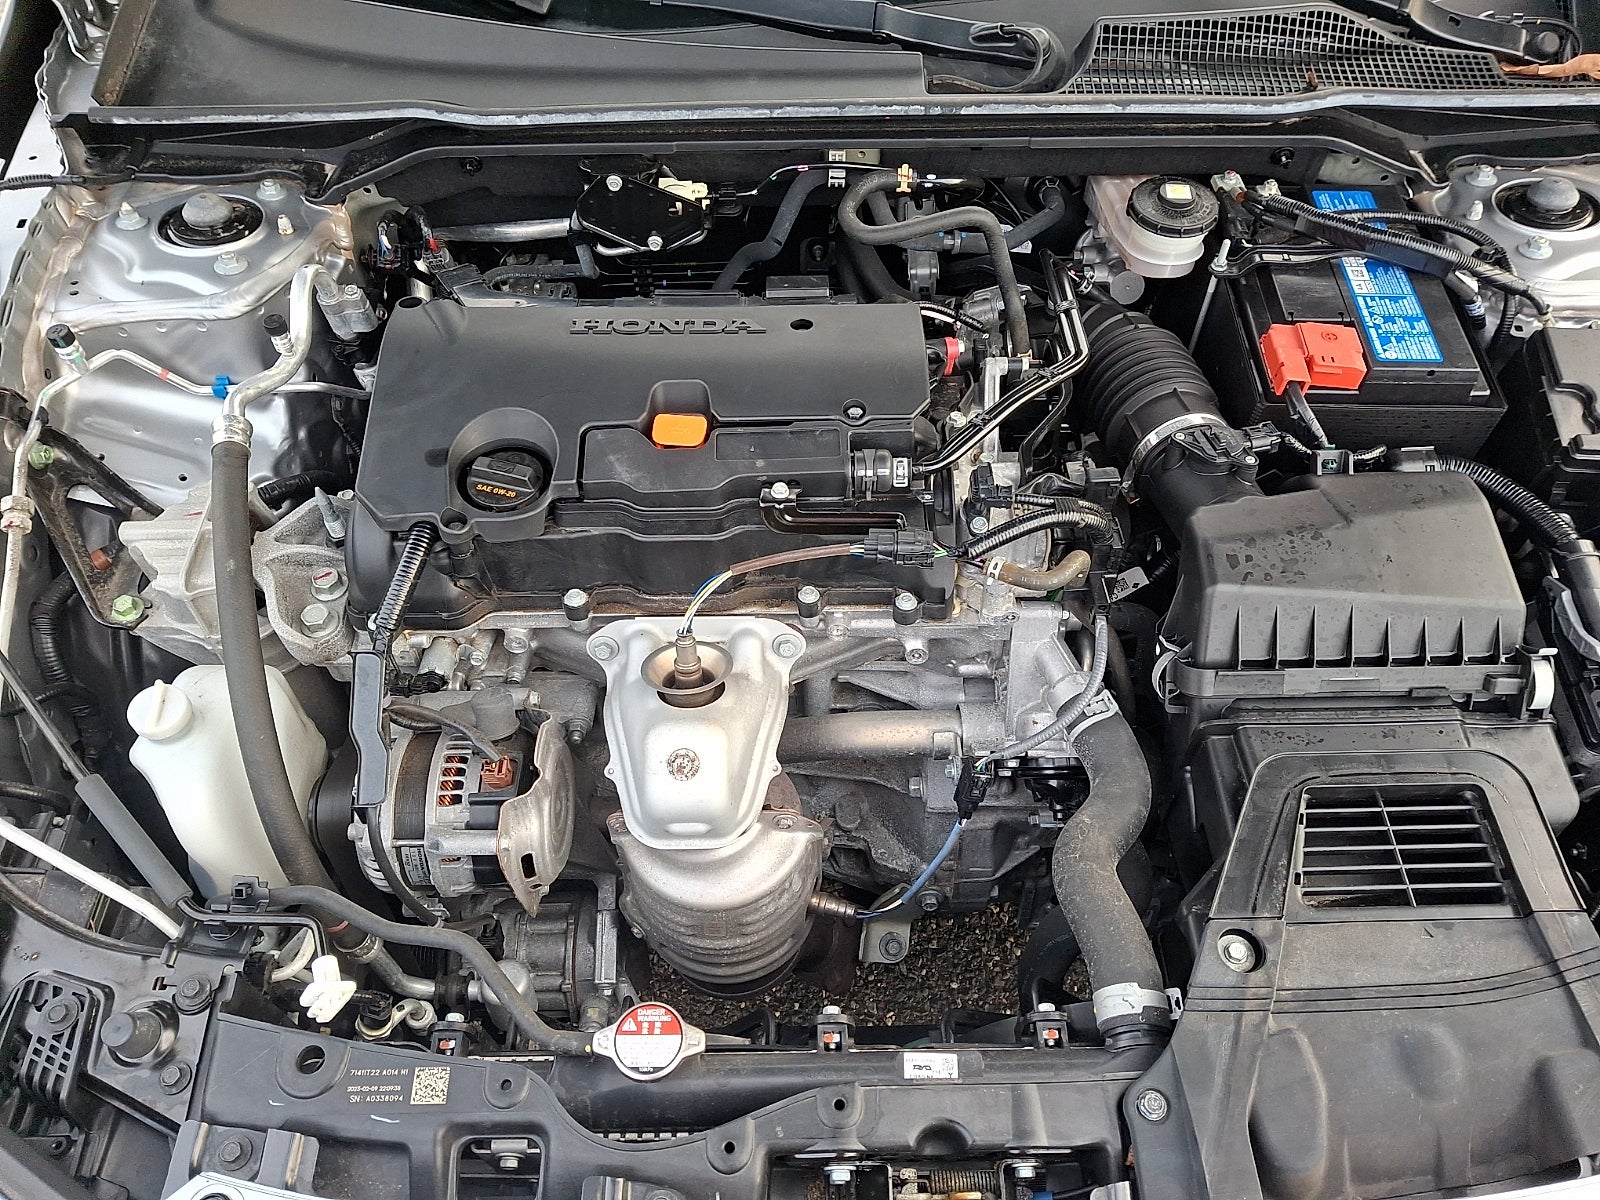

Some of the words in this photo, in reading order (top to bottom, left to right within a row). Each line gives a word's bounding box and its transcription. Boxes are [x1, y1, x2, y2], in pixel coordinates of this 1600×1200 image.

[569, 318, 767, 335] HONDA
[476, 484, 493, 492] SAE
[492, 487, 516, 498] 0W-20
[417, 848, 425, 871] HONDA
